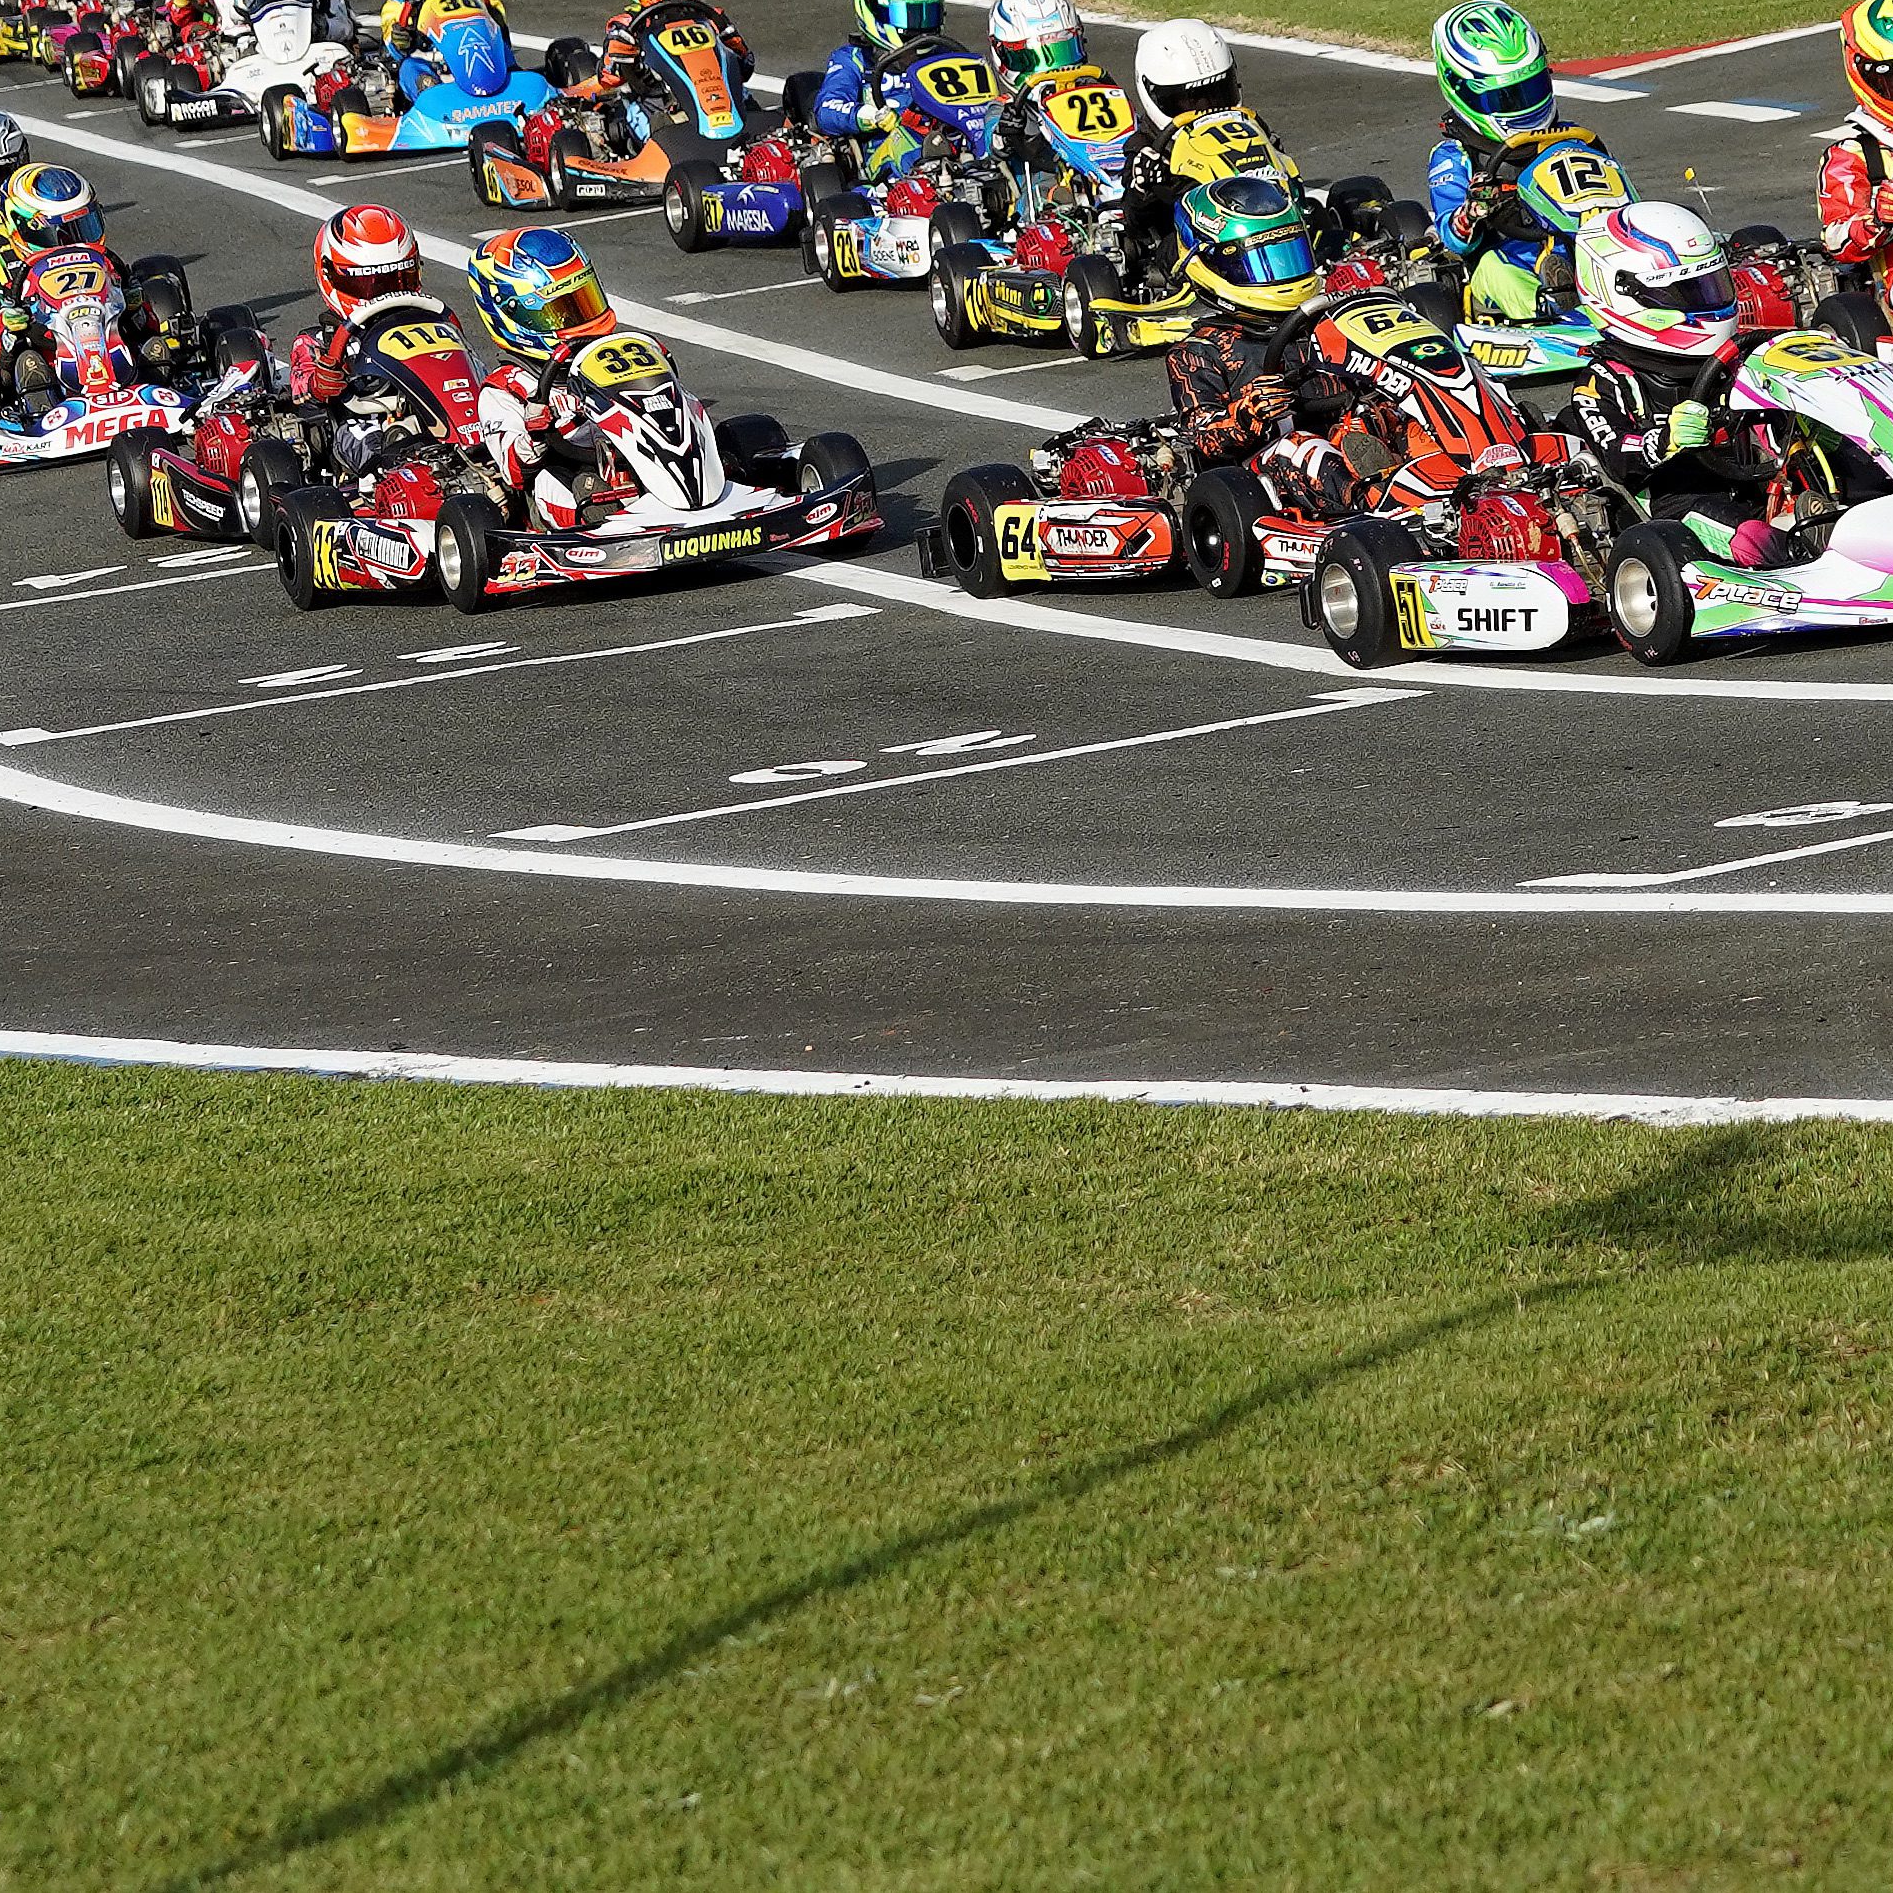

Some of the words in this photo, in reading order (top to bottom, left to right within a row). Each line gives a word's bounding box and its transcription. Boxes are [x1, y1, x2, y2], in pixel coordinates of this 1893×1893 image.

[670, 25, 710, 51] 46
[928, 64, 991, 98] 87
[1067, 91, 1118, 132] 23
[1201, 121, 1259, 145] 19
[1549, 156, 1609, 198] 12
[704, 198, 720, 232] 87
[726, 209, 775, 232] MARESIA
[836, 232, 858, 273] 23
[56, 271, 98, 295] 27
[388, 325, 461, 351] 114
[1362, 311, 1425, 335] 64
[595, 341, 659, 374] 33
[1345, 350, 1412, 398] THUNDER
[96, 391, 130, 405] SIP
[64, 408, 171, 450] MEGA
[662, 526, 762, 561] LUQUINHAS
[1001, 516, 1036, 561] 64
[1056, 528, 1110, 548] THUNDER
[1457, 608, 1539, 632] SHIFT
